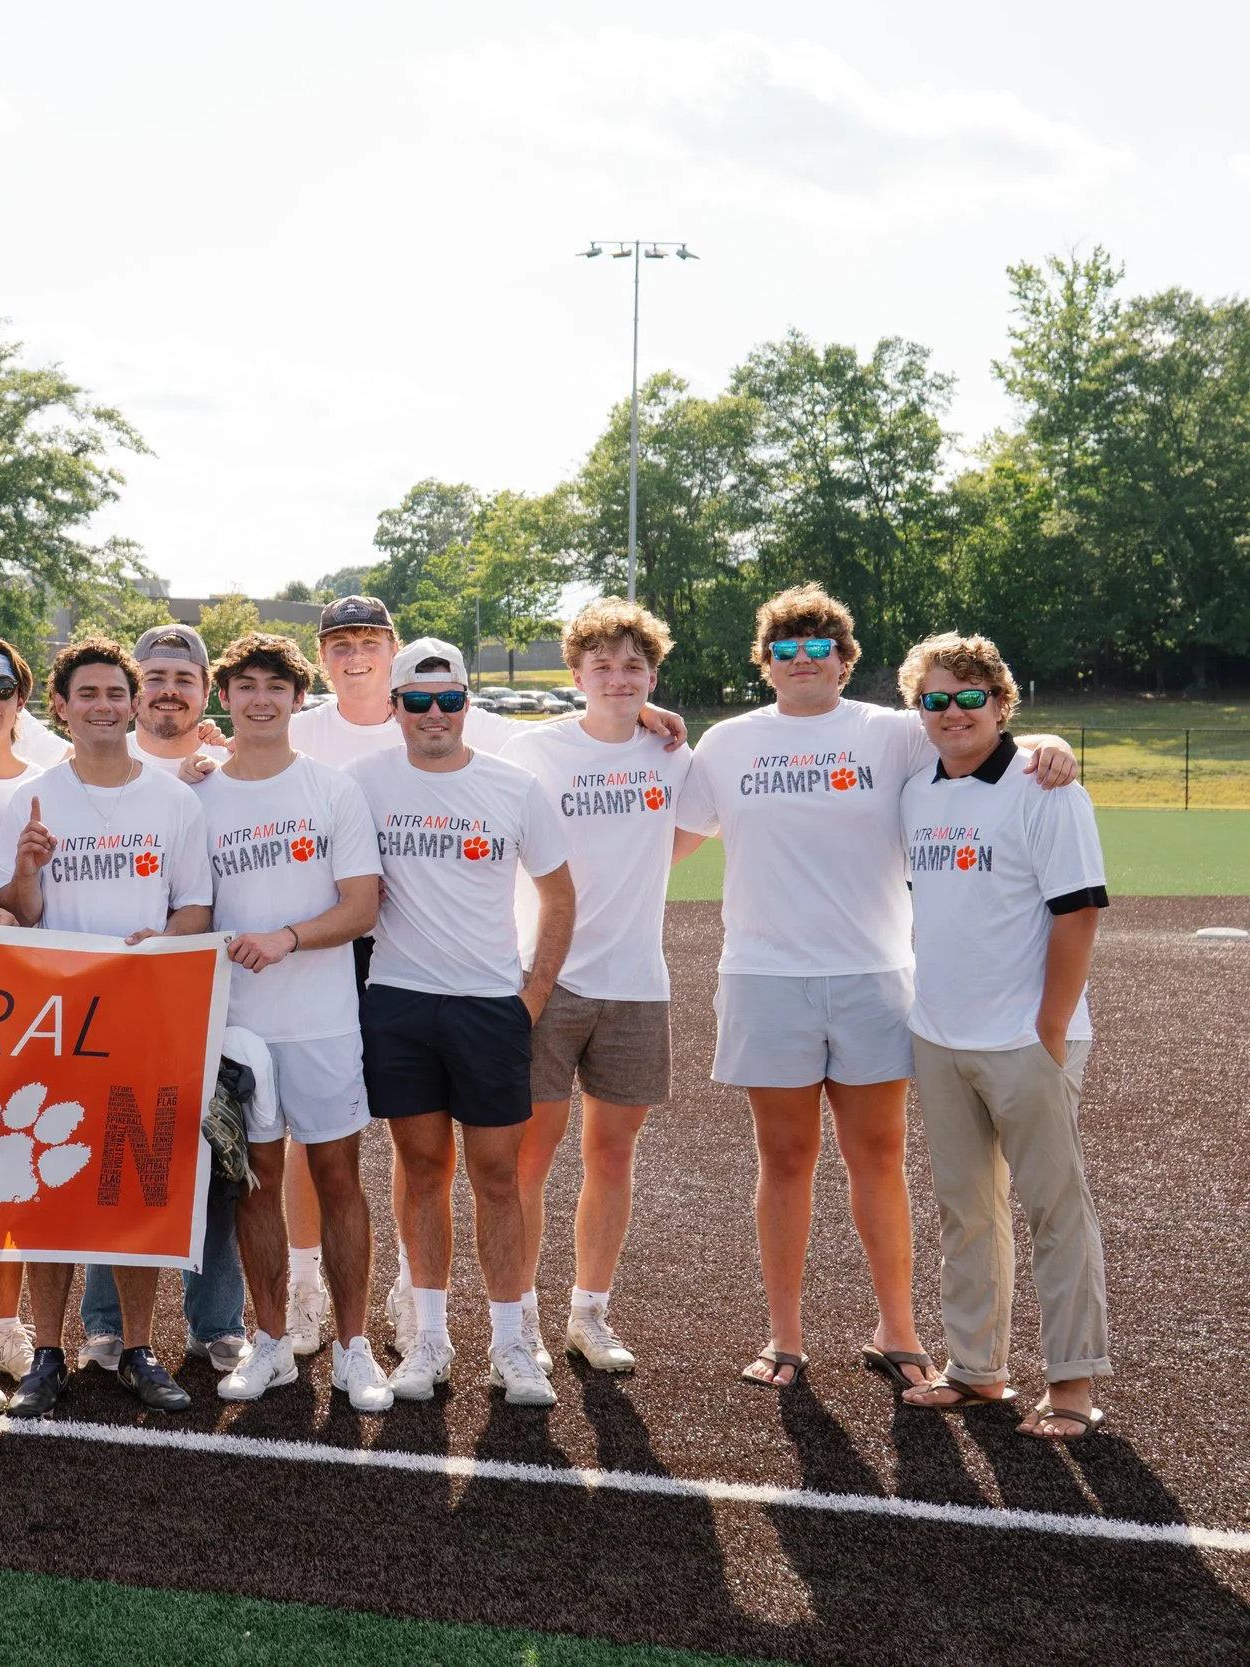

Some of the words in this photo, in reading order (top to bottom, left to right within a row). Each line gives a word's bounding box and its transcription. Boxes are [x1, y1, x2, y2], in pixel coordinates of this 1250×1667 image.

[753, 751, 856, 768] INTRAMURAL
[572, 770, 662, 788] INTRAMURAL
[740, 766, 874, 795] CHAMPIN
[561, 786, 672, 817] CHAMPIN
[218, 818, 316, 848] INTRAMURAL
[386, 814, 491, 833] INTRAMURAL
[61, 833, 162, 852] INTRAMURAL
[913, 827, 980, 841] NTRAMURAL
[377, 831, 505, 861] CHAMPIN
[212, 835, 328, 878] CHAMPIN
[909, 845, 993, 872] HAMPIN
[51, 851, 165, 883] CHAMPI
[157, 1097, 177, 1106] FLAG
[114, 1124, 126, 1168] VOLLEYBALL
[136, 1161, 169, 1170] SOFTBALL
[100, 1174, 121, 1184] FLAG
[140, 1174, 168, 1182] EFFORT
